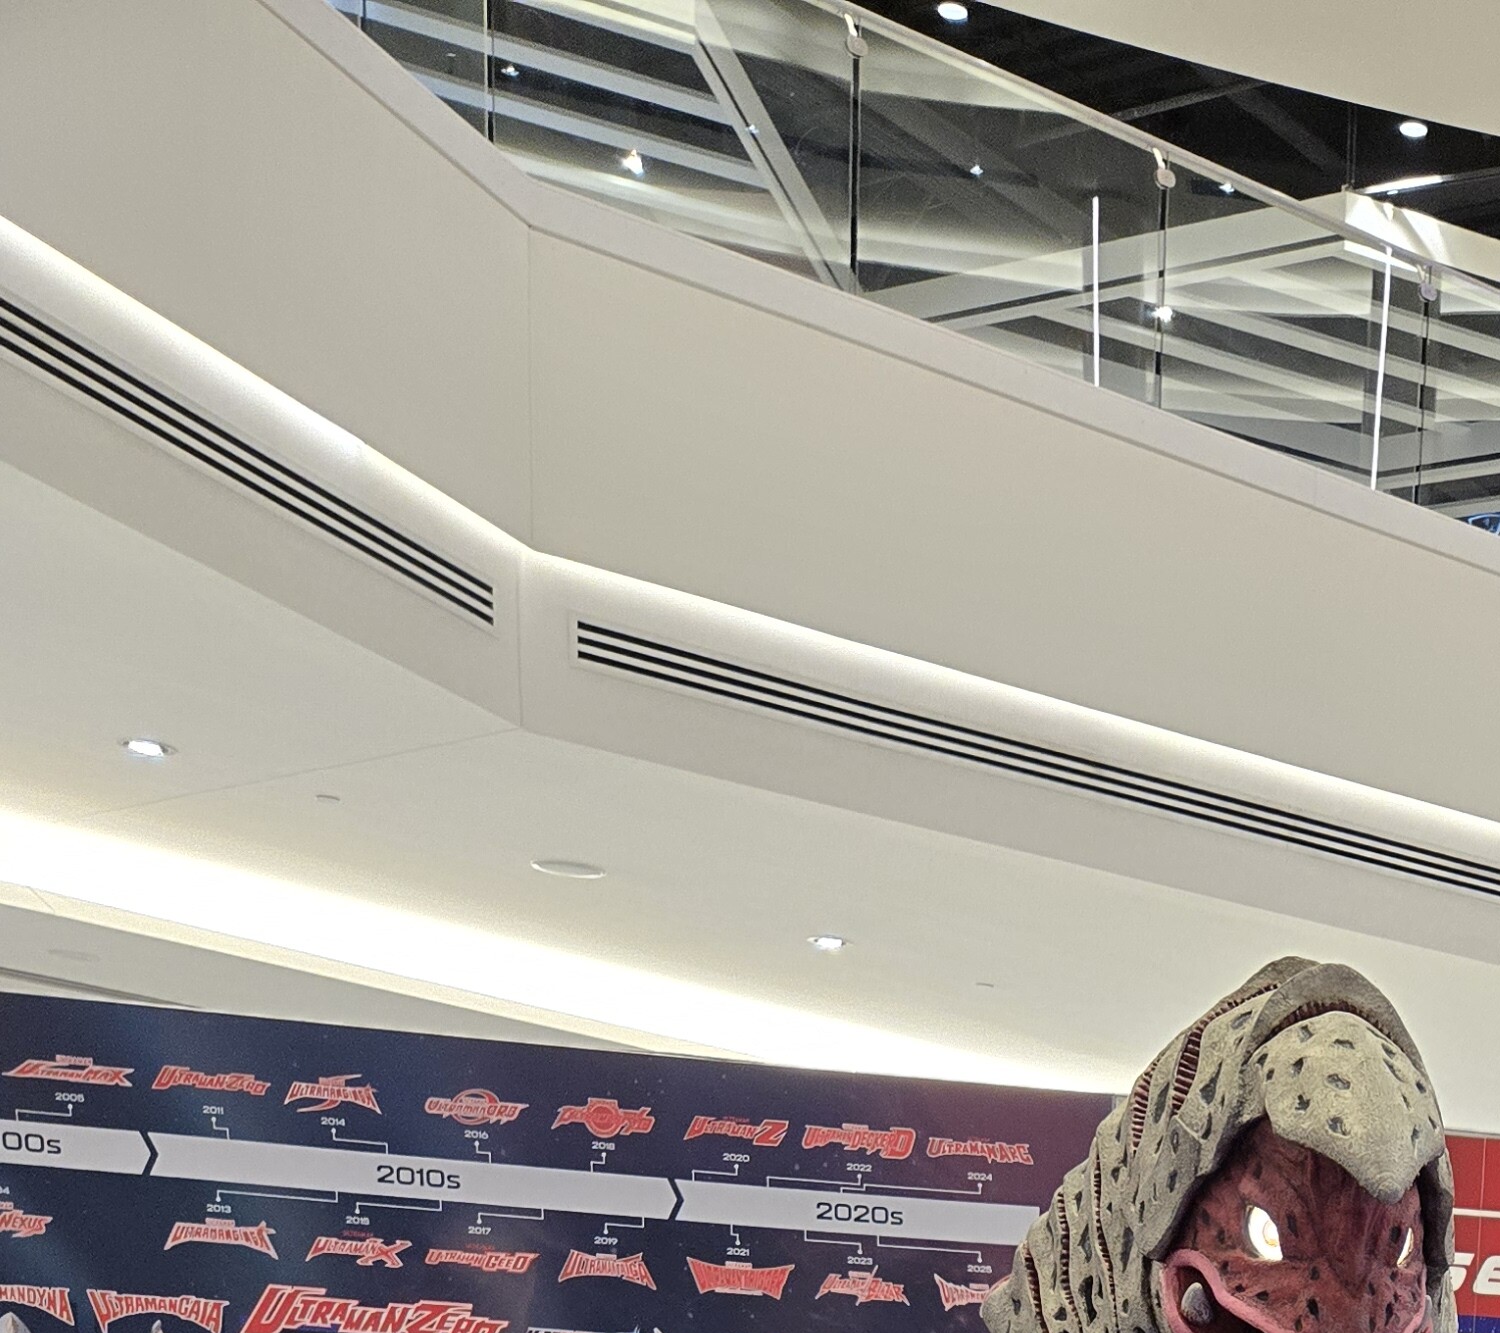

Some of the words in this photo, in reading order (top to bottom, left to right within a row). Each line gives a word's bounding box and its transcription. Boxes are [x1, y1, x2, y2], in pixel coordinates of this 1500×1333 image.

[202, 1106, 224, 1115] 2011
[320, 1117, 346, 1126] 2014
[464, 1130, 489, 1139] 2016
[722, 1153, 749, 1162] 2020
[846, 1163, 872, 1172] 2022
[376, 1165, 461, 1190] 2010s
[967, 1172, 993, 1181] 2024
[206, 1204, 231, 1213] 2013
[815, 1201, 904, 1226] 2020s
[468, 1226, 491, 1235] 2017
[594, 1236, 618, 1245] 2019
[726, 1247, 750, 1256] 2021
[847, 1256, 873, 1265] 2023
